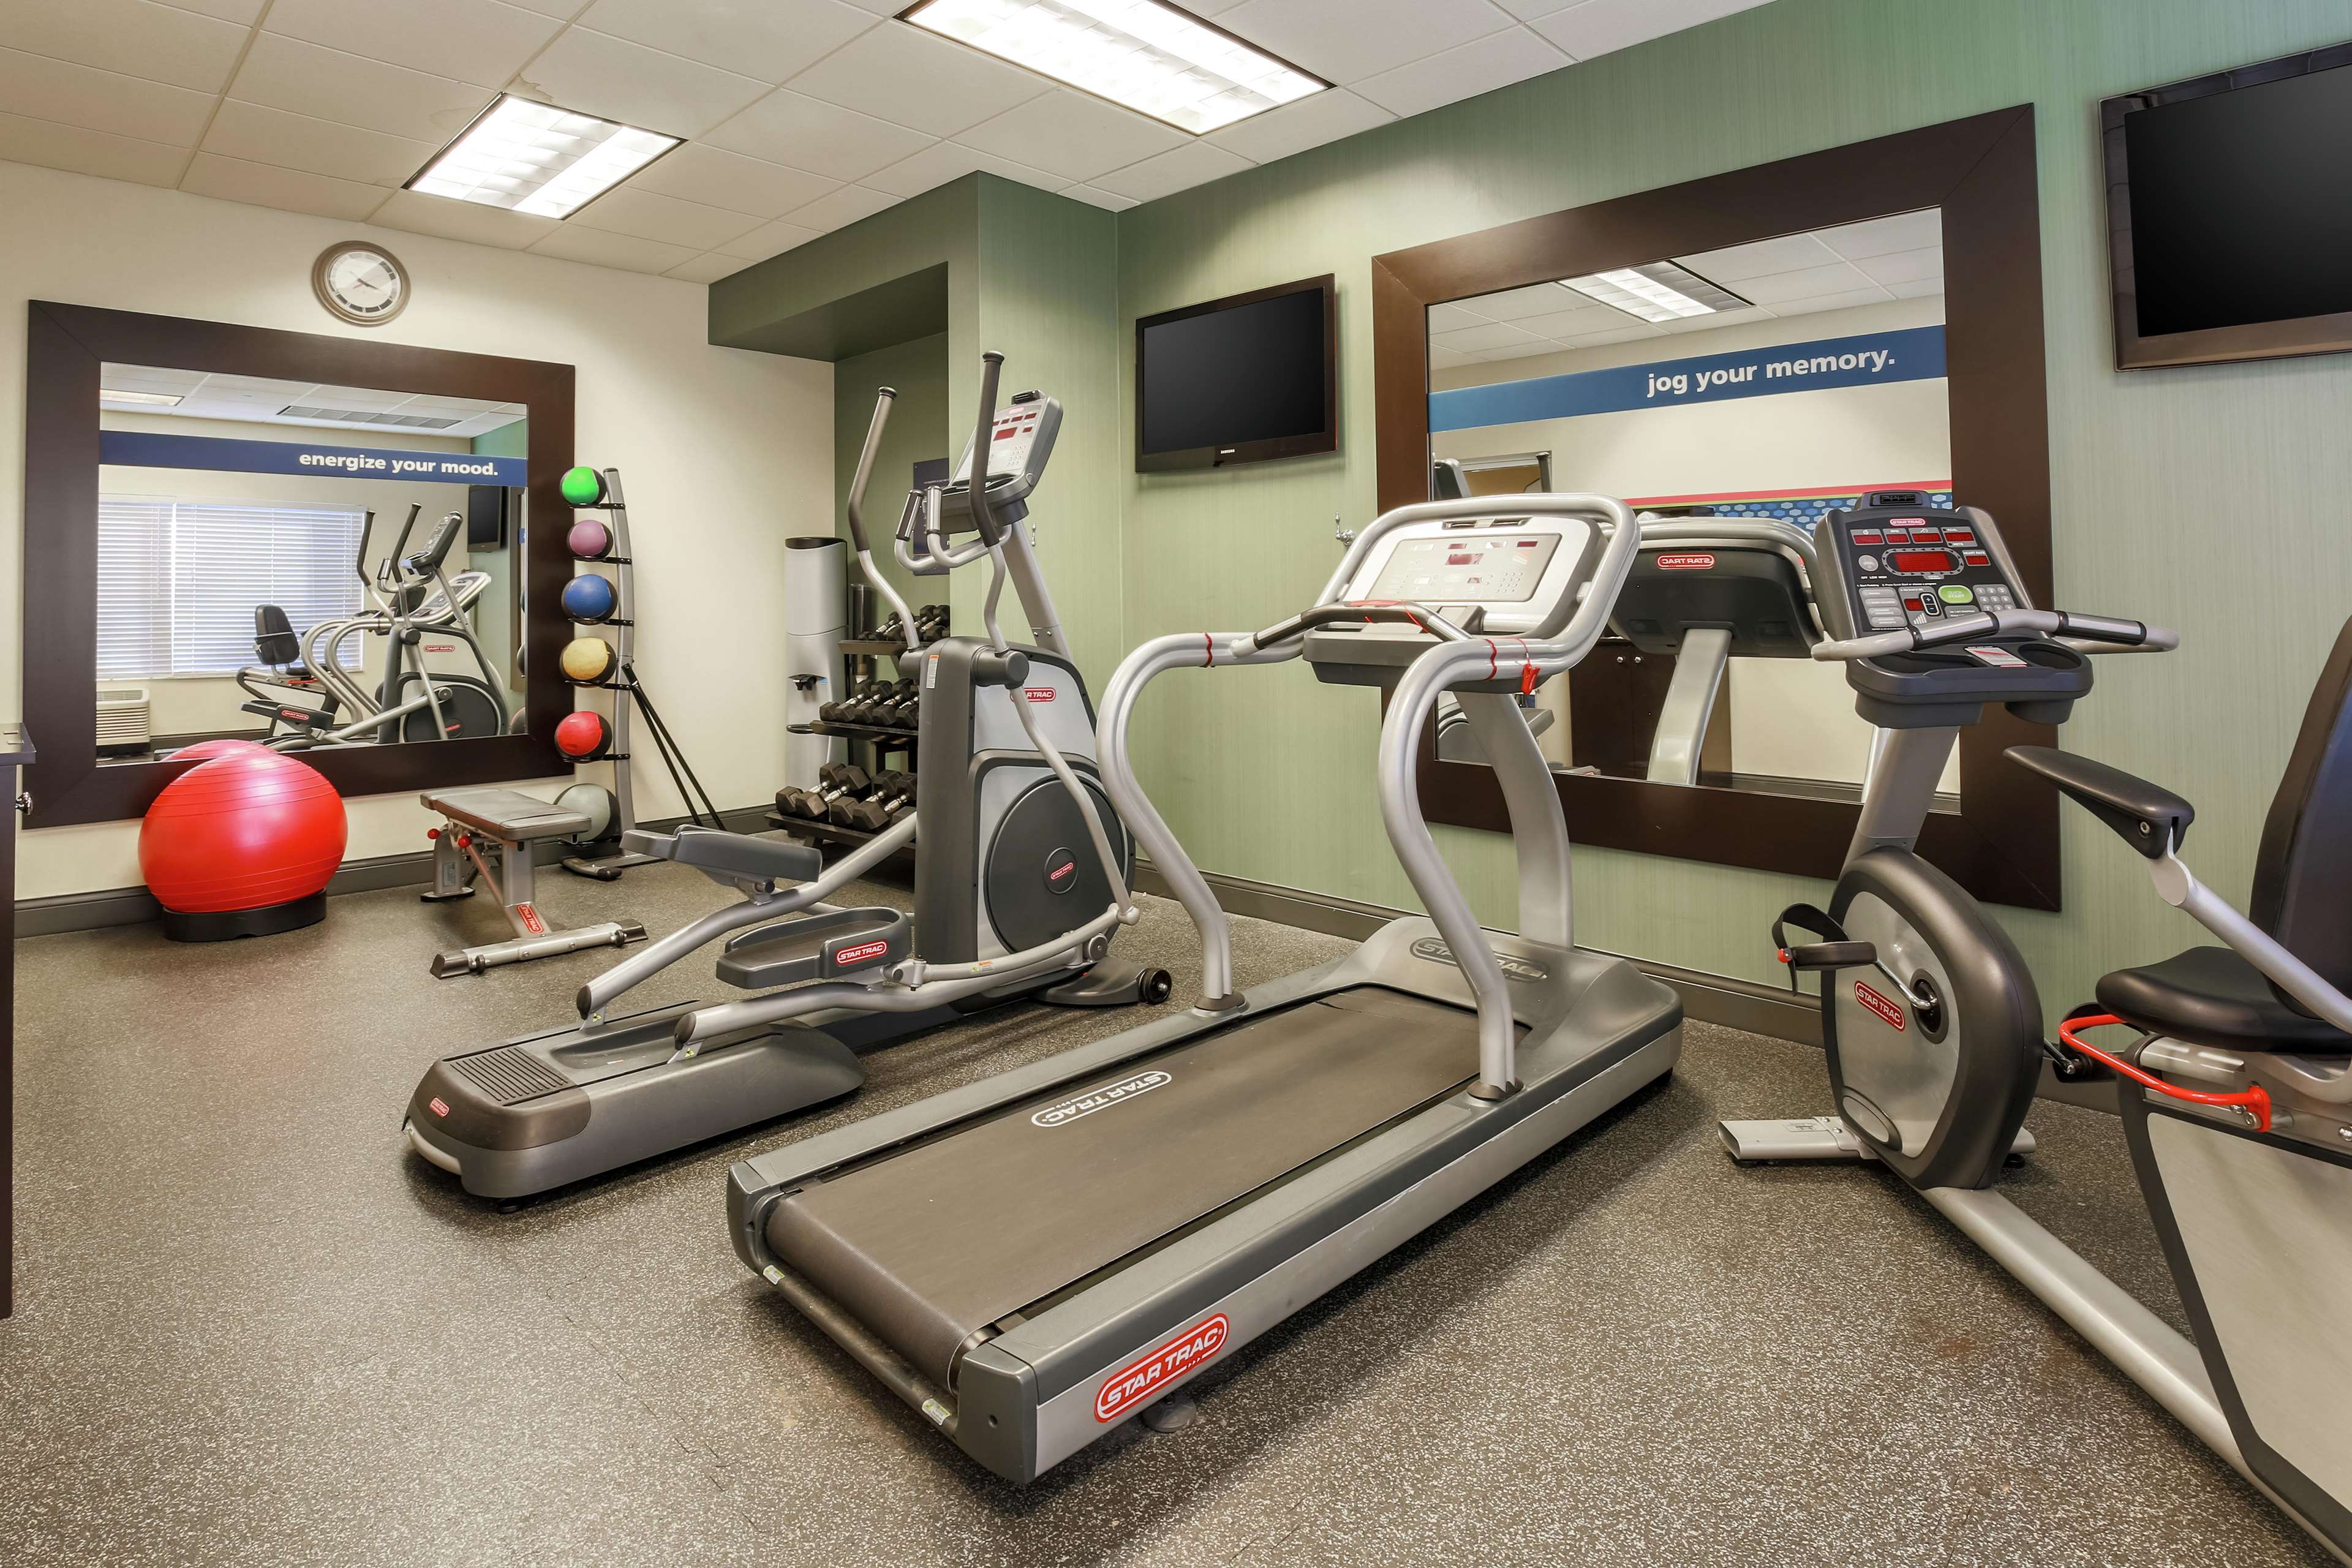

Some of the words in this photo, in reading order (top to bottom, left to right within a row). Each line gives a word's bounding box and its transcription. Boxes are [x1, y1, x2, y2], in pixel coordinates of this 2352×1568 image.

[1646, 372, 1687, 398] jog
[1695, 365, 1758, 392] your
[1766, 350, 1895, 379] memory.
[299, 454, 386, 471] energize
[391, 459, 437, 473] your
[441, 462, 499, 476] mood.
[839, 950, 861, 960] STAR
[862, 944, 883, 955] TRAC
[1858, 989, 1878, 1008] STAR
[1879, 1001, 1901, 1023] TRAC
[1106, 1074, 1163, 1098] STAR
[1045, 1096, 1109, 1122] TRAC
[1102, 1362, 1162, 1410] STAR
[1164, 1327, 1218, 1371] TRAC
